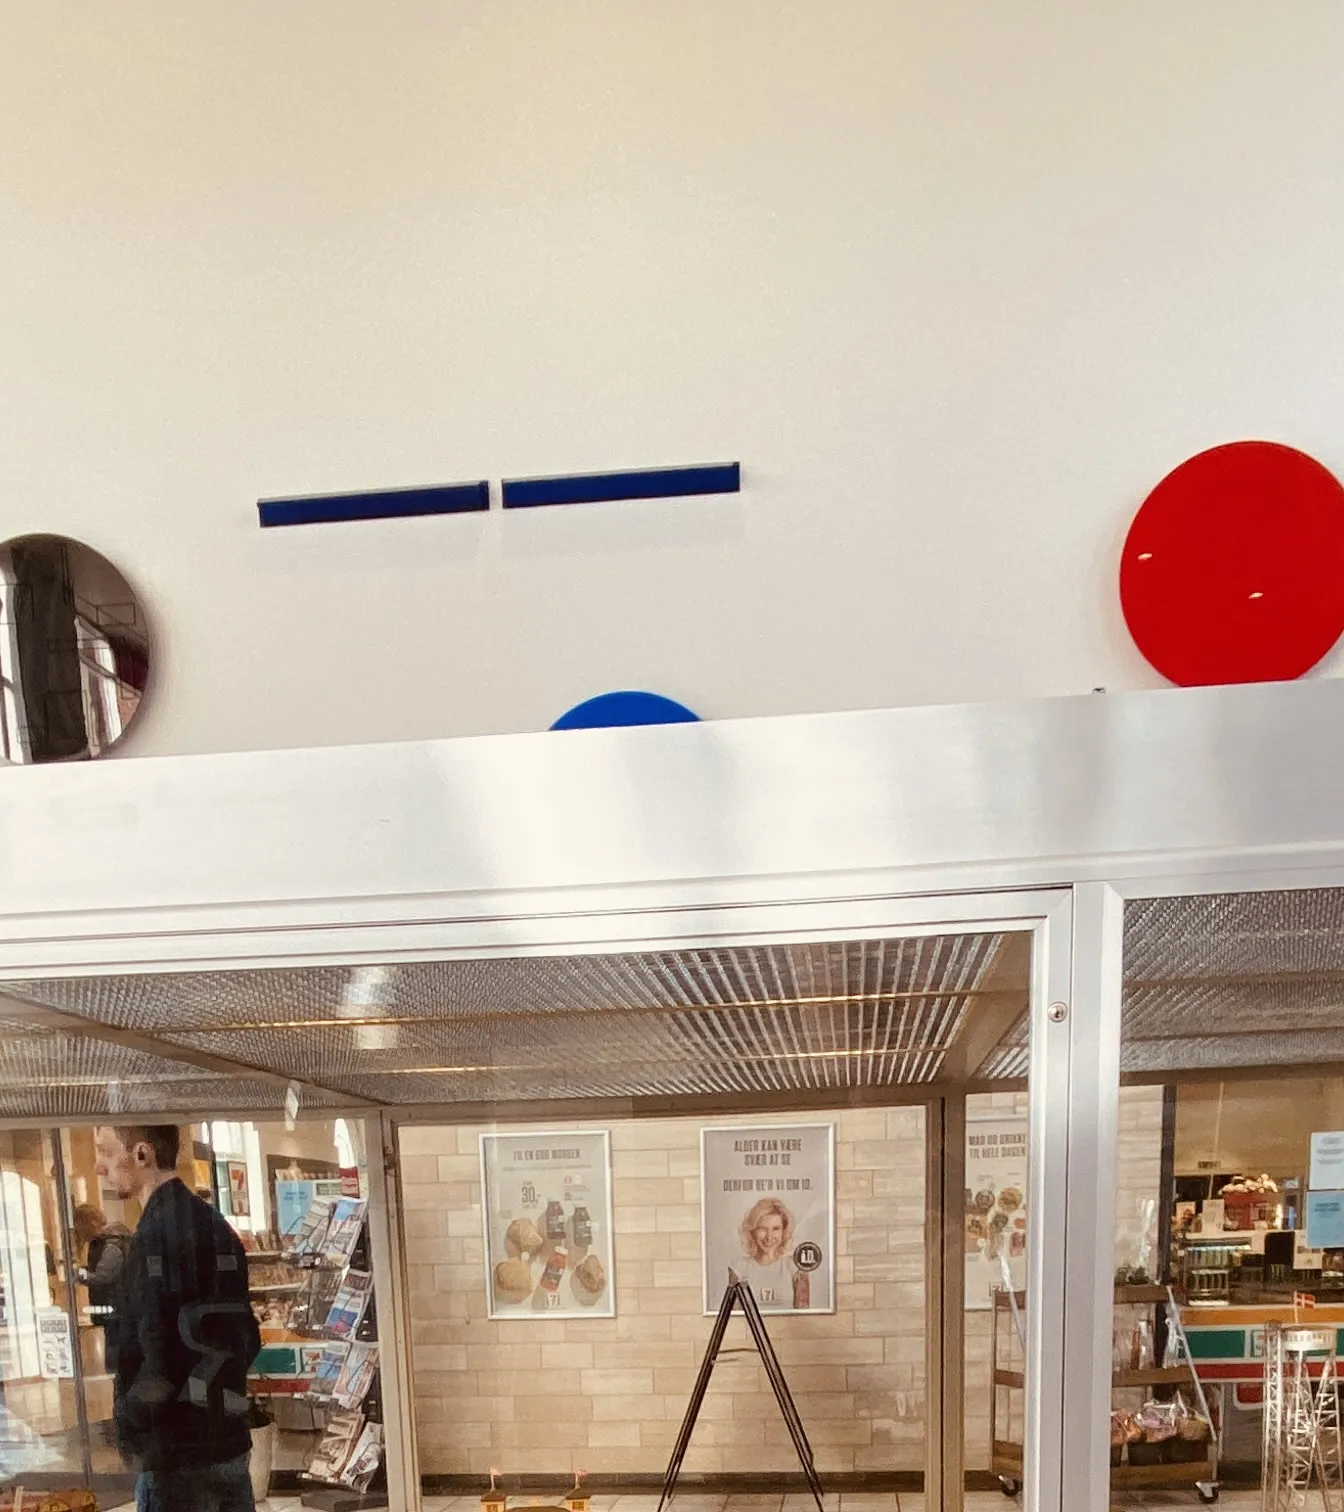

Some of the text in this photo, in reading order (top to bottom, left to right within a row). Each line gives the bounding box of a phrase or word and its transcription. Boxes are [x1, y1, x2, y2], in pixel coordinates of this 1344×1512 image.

[734, 1138, 802, 1152] ALDER KAN VÆRE
[744, 1153, 767, 1166] SVÆR
[769, 1153, 778, 1166] AT
[723, 1179, 753, 1192] DERFOR
[775, 1179, 785, 1191] VI
[786, 1178, 799, 1191] OM
